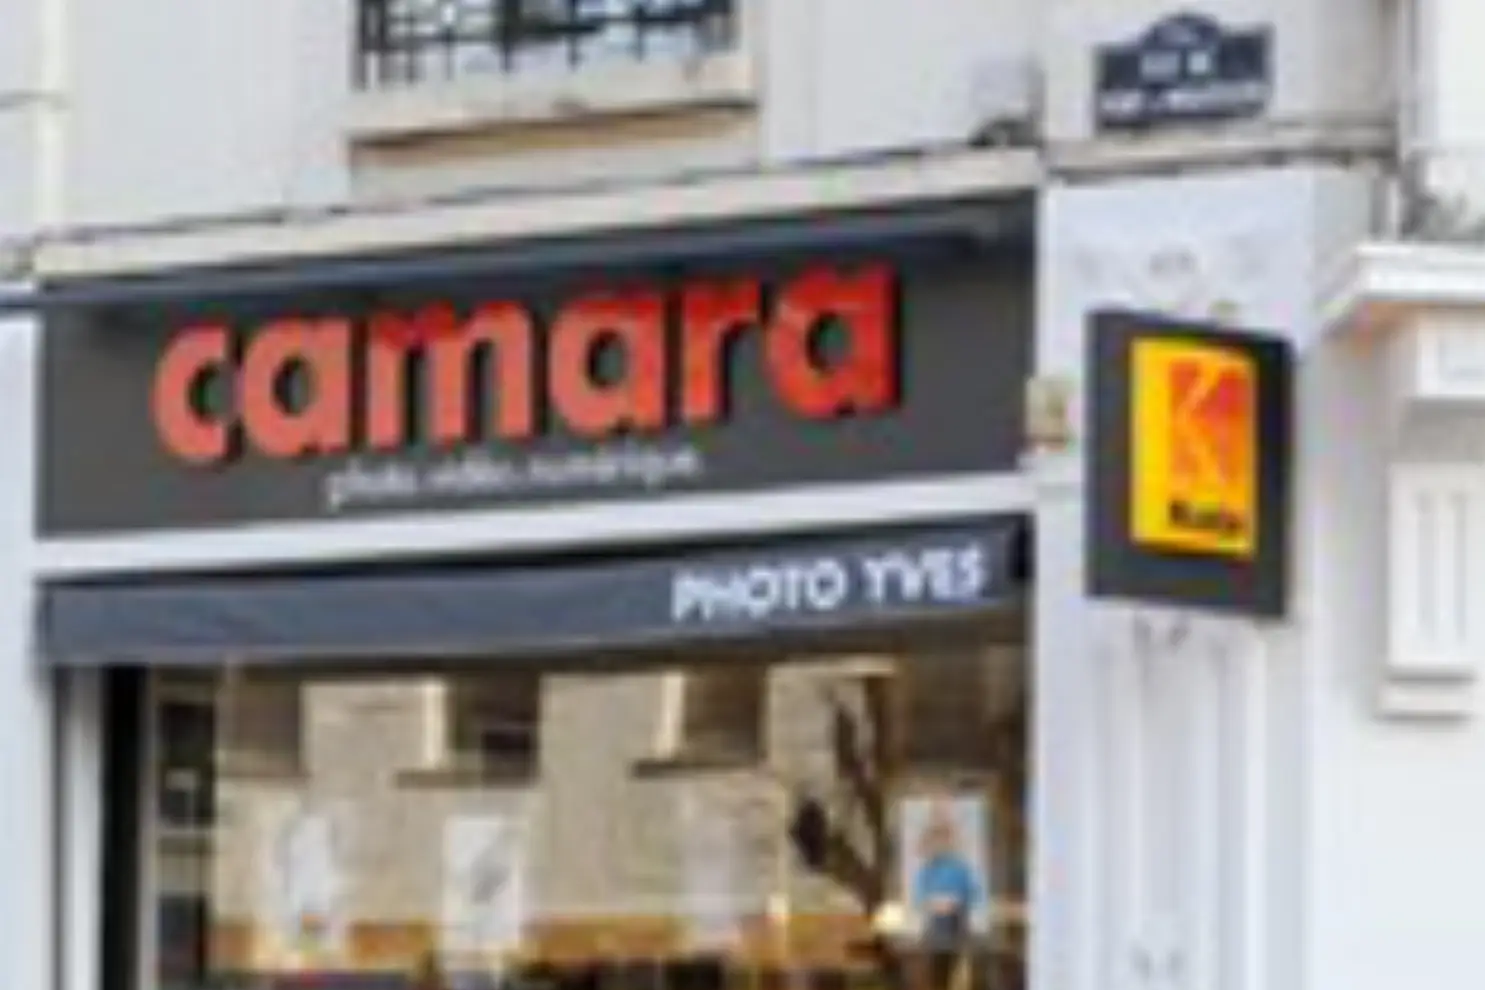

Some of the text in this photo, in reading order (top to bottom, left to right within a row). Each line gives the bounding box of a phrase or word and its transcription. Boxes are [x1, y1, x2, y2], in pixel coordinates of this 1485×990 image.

[150, 262, 898, 464] camara
[671, 542, 986, 623] PHOTO YVES
